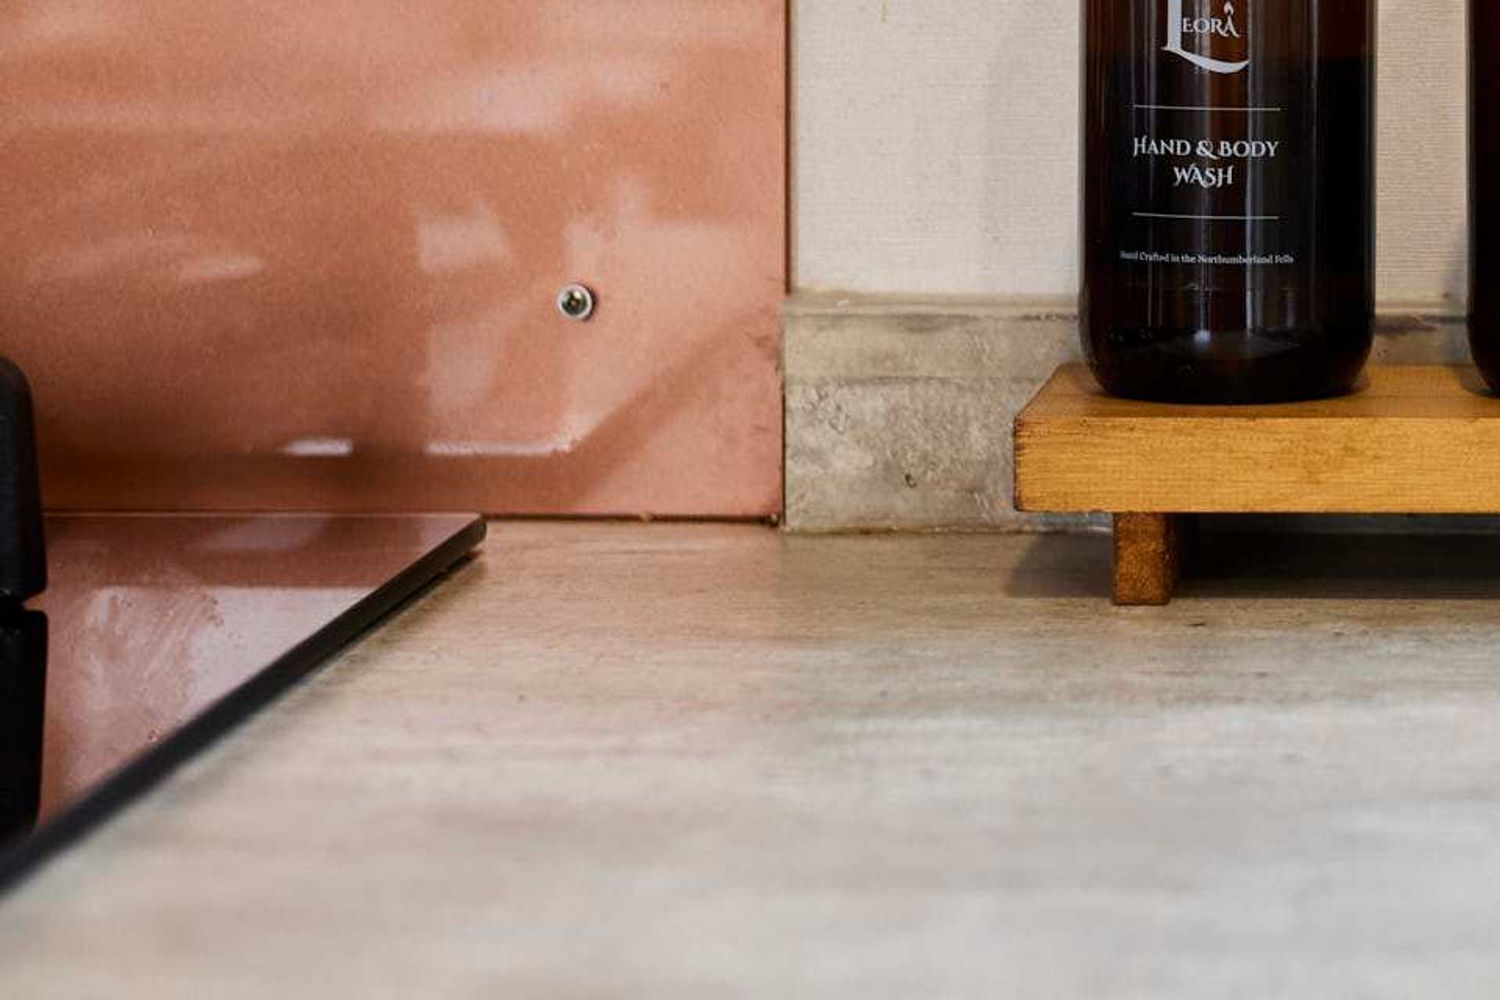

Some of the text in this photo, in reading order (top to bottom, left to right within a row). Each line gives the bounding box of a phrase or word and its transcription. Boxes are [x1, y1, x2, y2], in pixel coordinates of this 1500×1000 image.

[1196, 138, 1220, 160] &
[1219, 140, 1279, 158] BODY
[1173, 163, 1235, 189] WASH
[1139, 251, 1170, 263] Crafted
[1170, 252, 1180, 263] in
[1181, 252, 1196, 264] the
